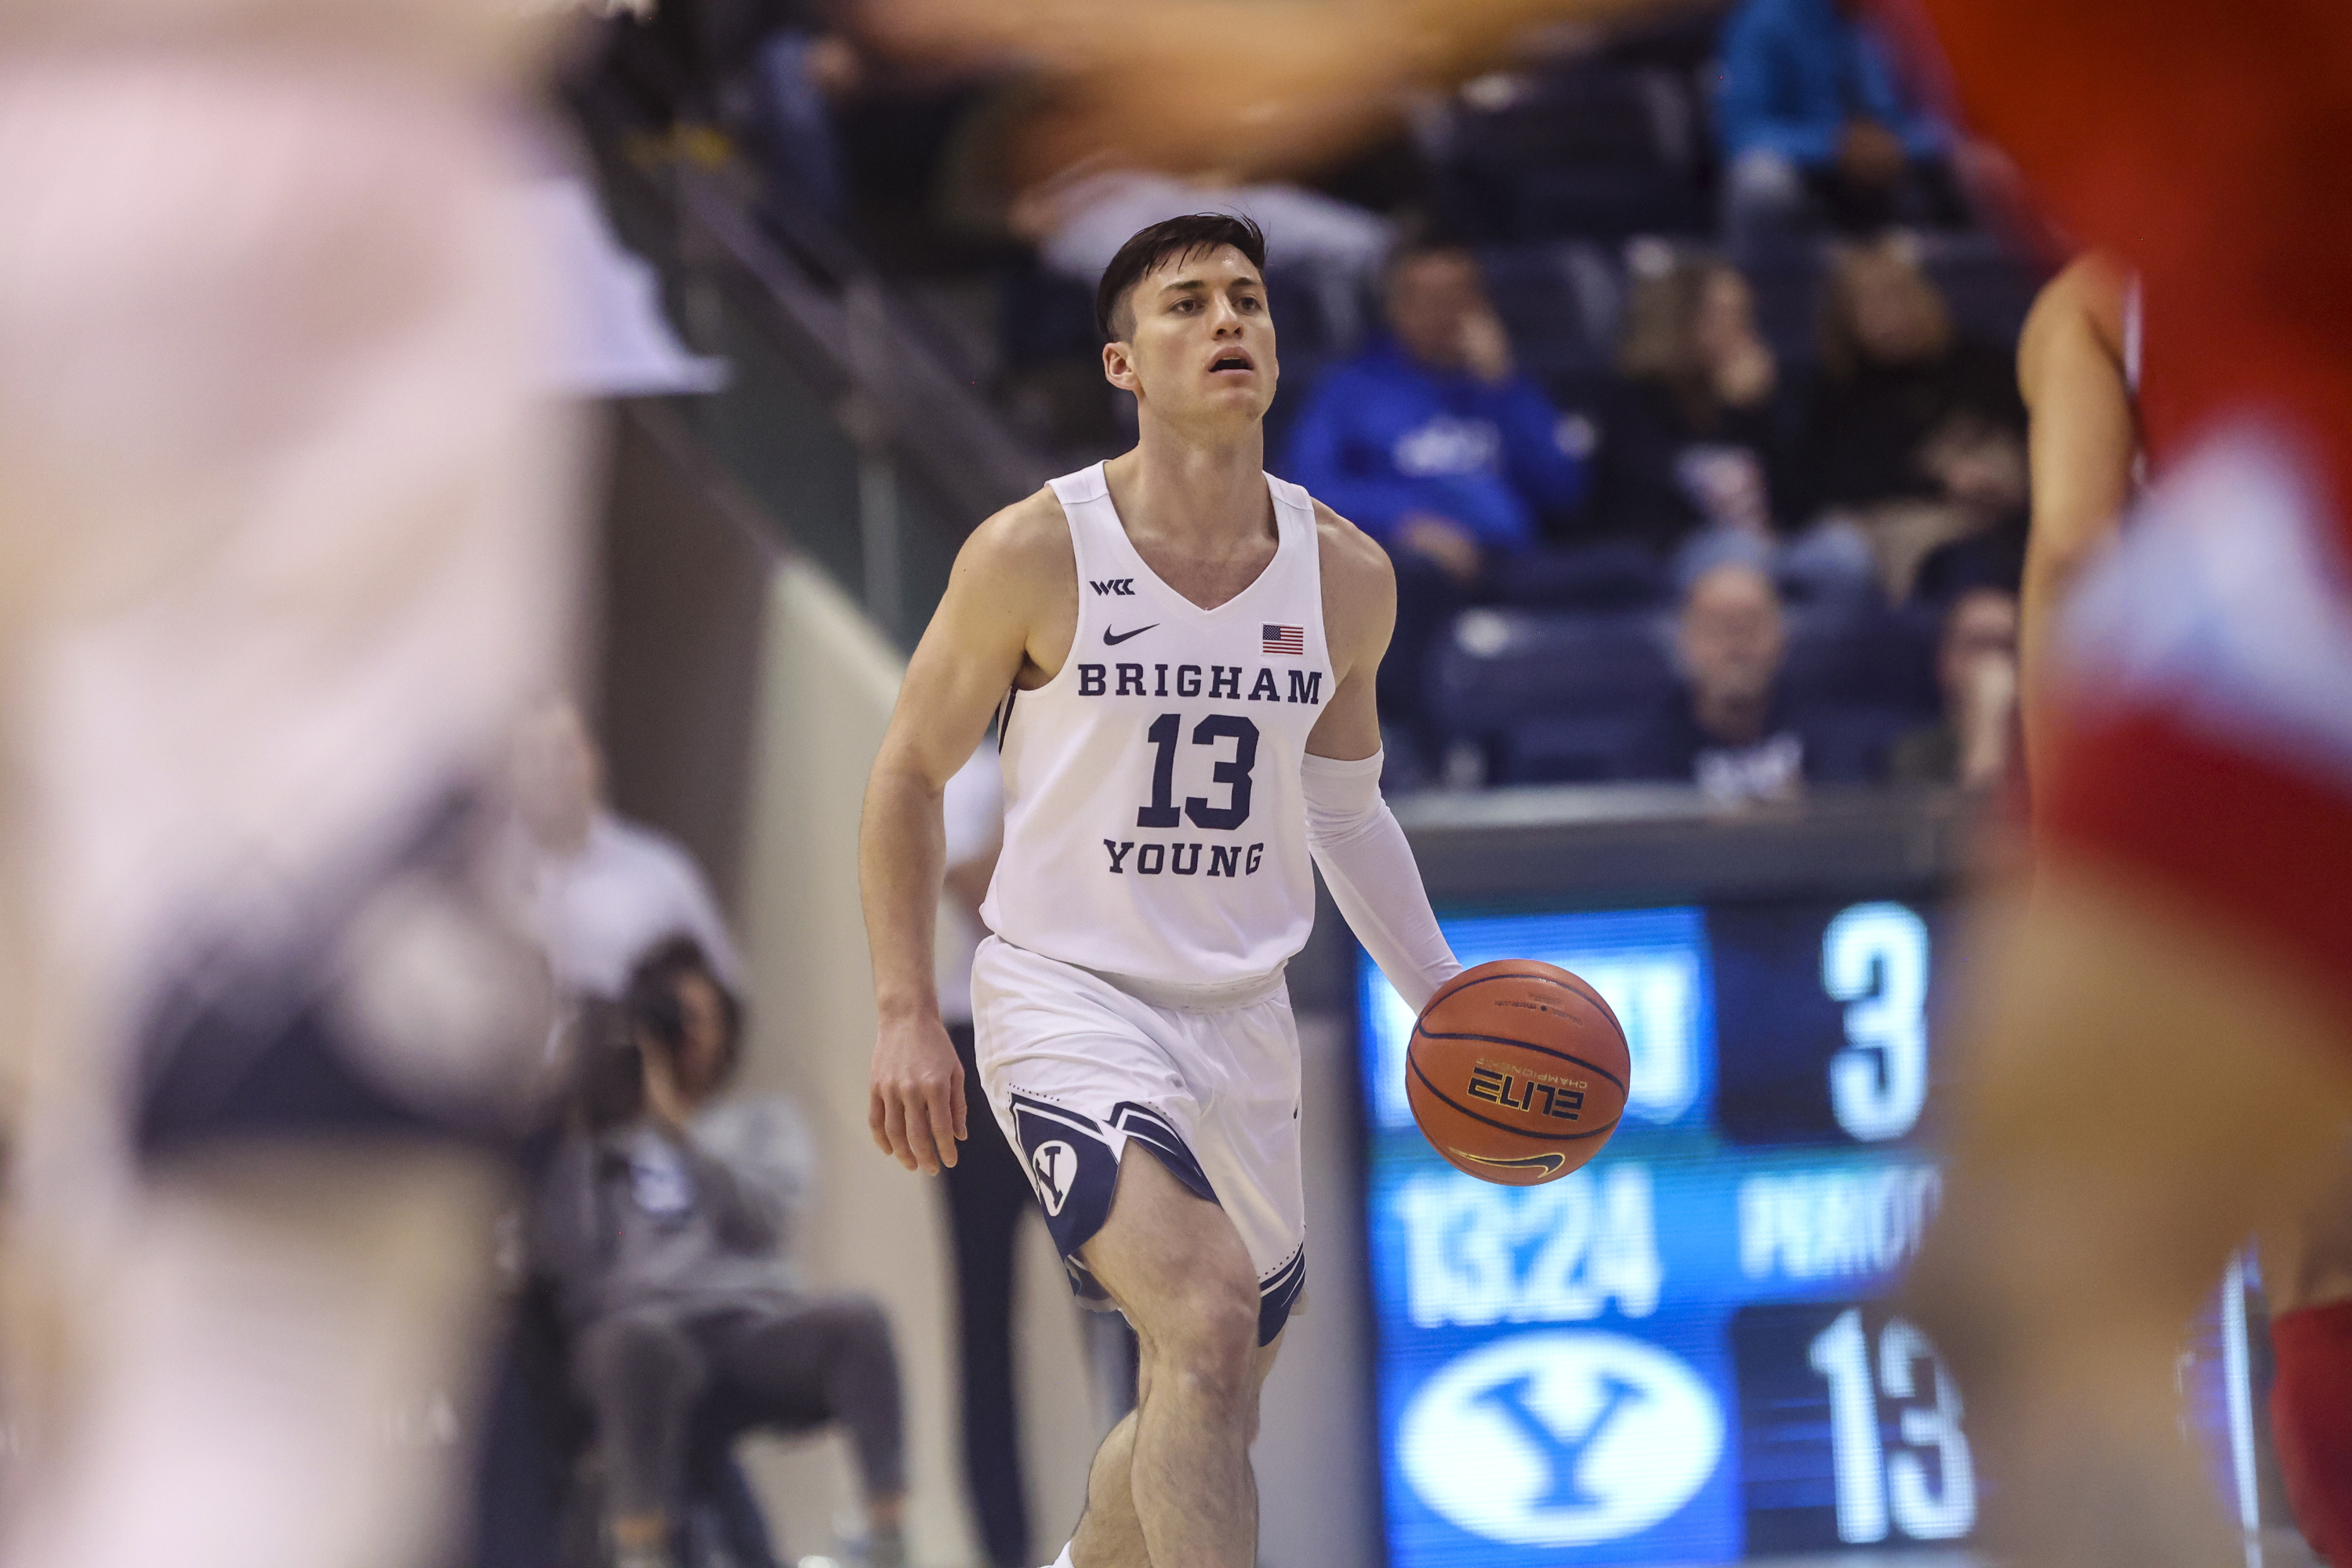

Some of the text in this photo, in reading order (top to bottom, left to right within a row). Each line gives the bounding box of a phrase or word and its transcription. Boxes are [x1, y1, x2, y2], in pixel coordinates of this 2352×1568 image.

[1078, 663, 1322, 705] BRIGHAM
[1137, 713, 1260, 830] 13
[1103, 838, 1264, 877] YOUNG
[1823, 902, 1930, 1142] 3
[1467, 1066, 1584, 1120] ELITE
[1475, 1058, 1588, 1089] CHAMPIONSP
[1468, 1374, 1653, 1509] Y
[1809, 1308, 1976, 1543] 13
